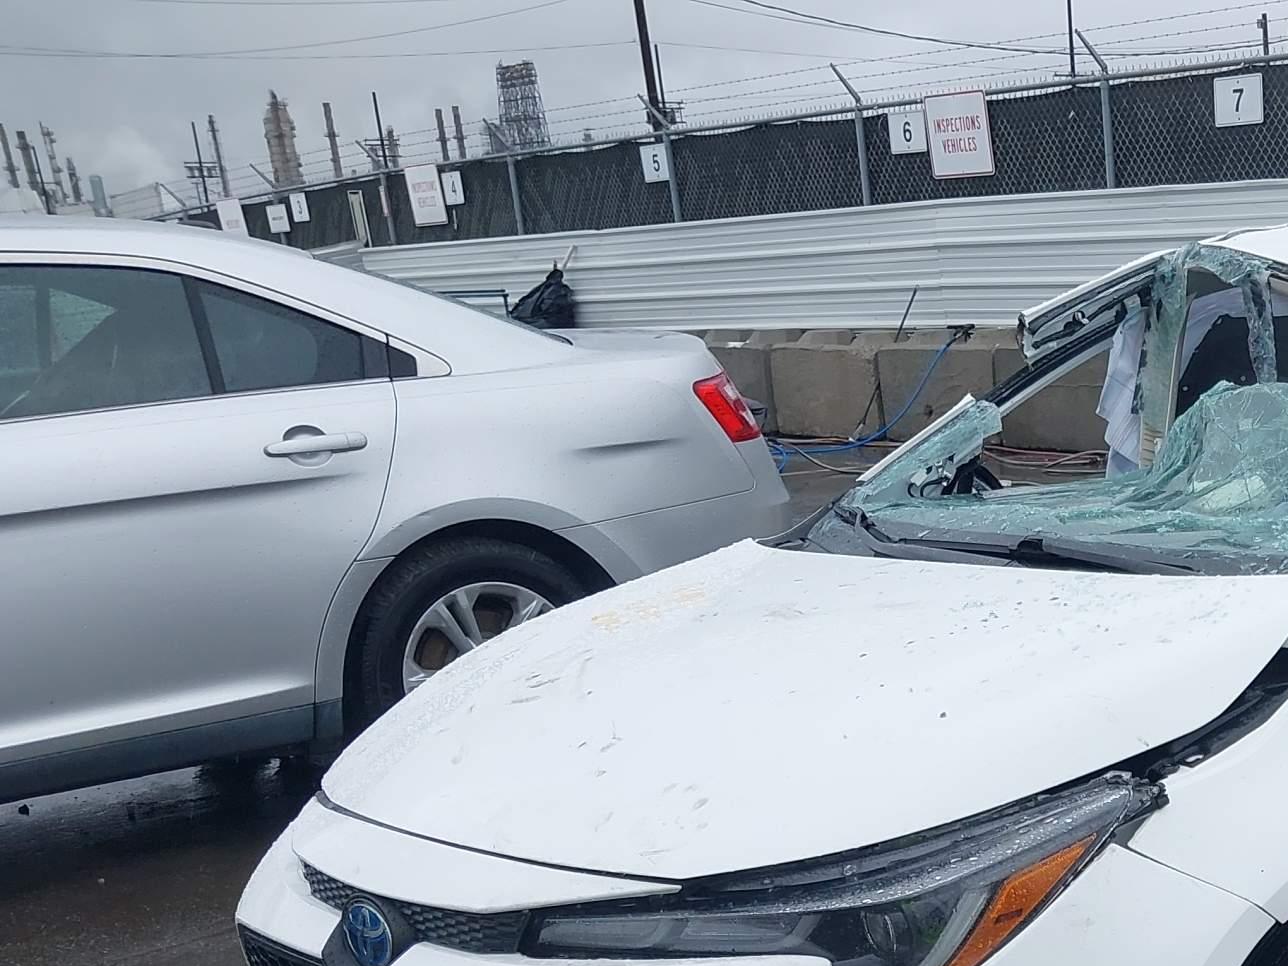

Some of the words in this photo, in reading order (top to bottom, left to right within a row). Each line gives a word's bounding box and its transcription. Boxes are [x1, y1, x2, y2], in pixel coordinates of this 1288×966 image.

[1232, 88, 1244, 112] 7
[903, 121, 913, 142] 6
[933, 115, 982, 134] INSPECTIONS
[942, 137, 977, 153] VEHICLES
[652, 154, 660, 172] 5
